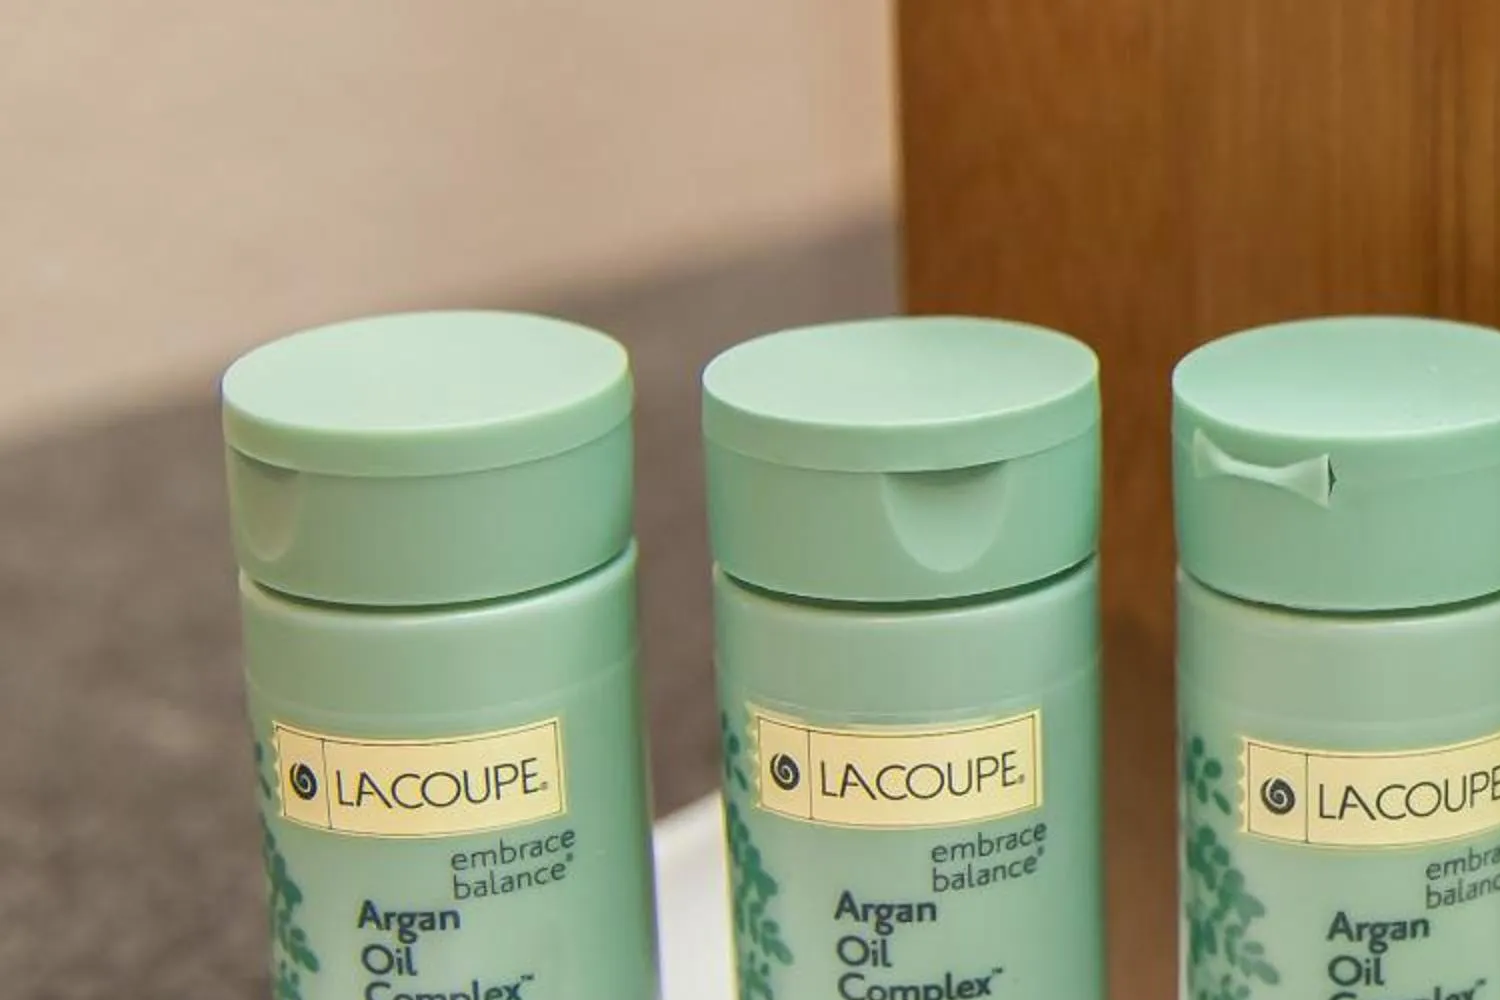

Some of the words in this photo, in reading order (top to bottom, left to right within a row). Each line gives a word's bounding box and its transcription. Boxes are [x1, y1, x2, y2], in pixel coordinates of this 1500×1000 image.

[450, 829, 576, 871] embrace
[931, 820, 1048, 863] embrace
[357, 899, 461, 944] Argan
[834, 890, 937, 936] Argan
[1325, 911, 1431, 954] Argan
[361, 943, 418, 976] Oil
[836, 935, 892, 968] Oil
[1327, 954, 1385, 987] Oil
